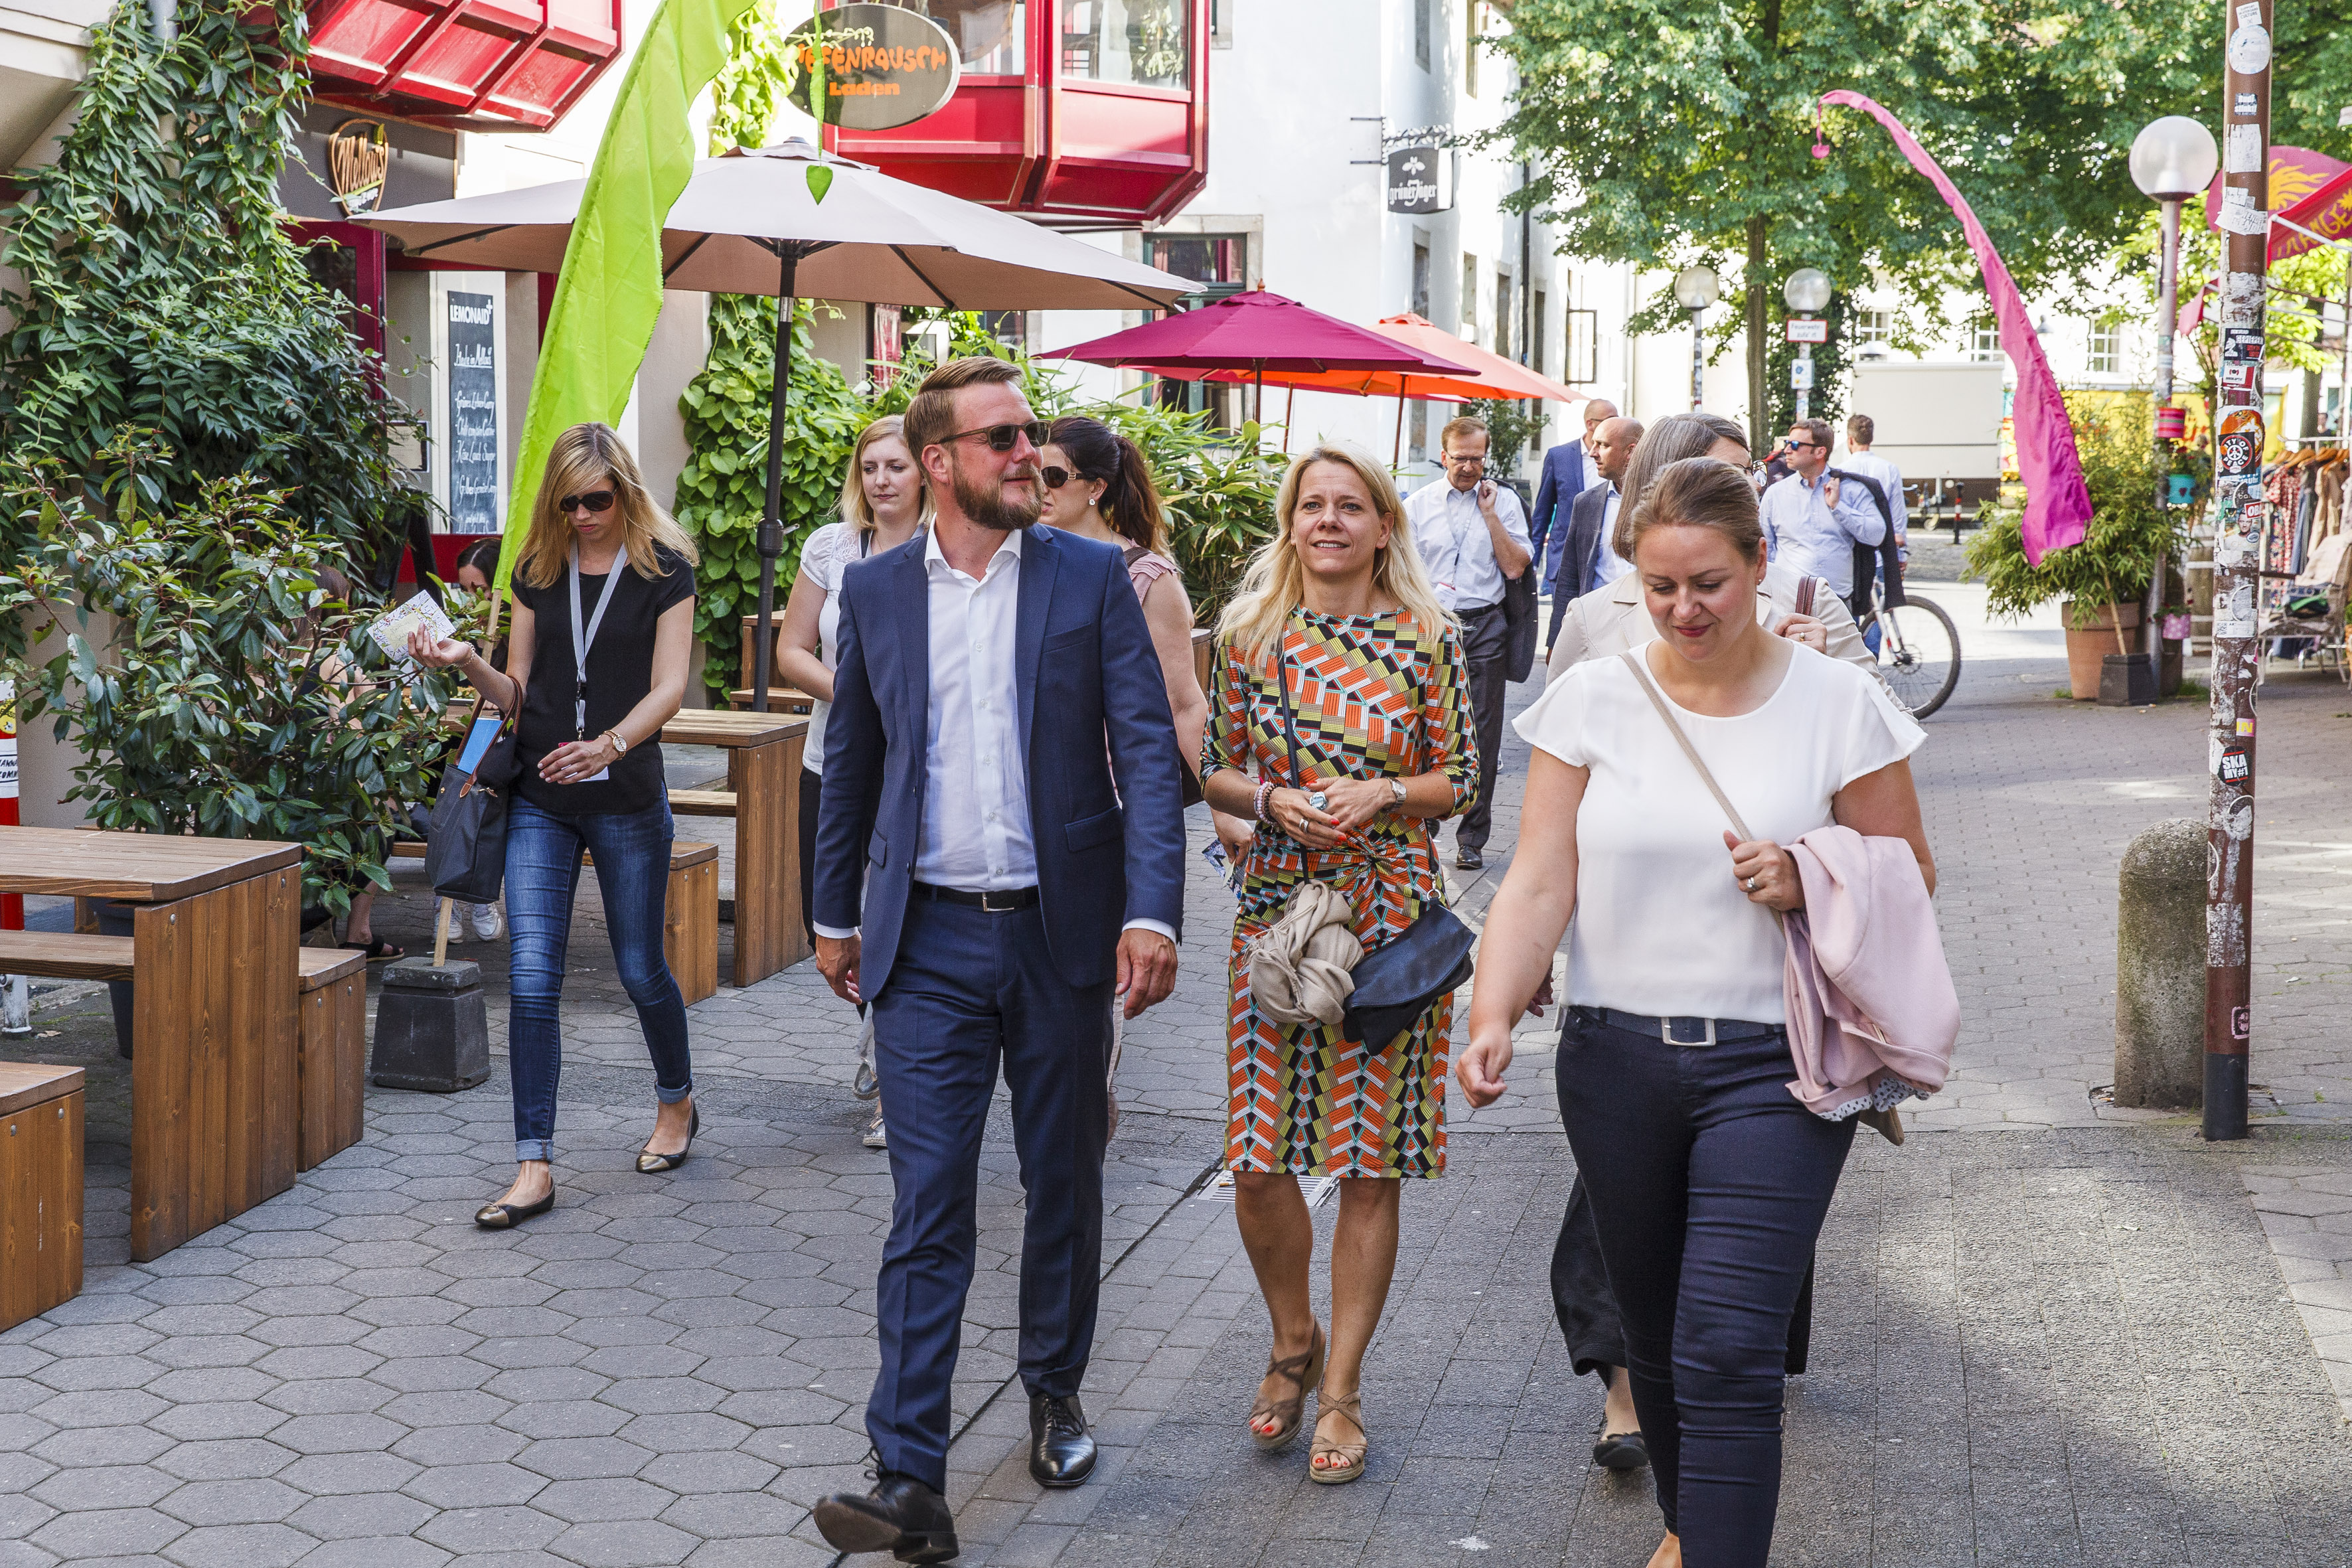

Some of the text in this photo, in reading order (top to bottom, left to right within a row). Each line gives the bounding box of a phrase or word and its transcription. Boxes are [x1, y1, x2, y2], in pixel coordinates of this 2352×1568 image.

[798, 43, 947, 74] IEFENRAUSCH
[829, 82, 900, 96] Laden
[2224, 438, 2249, 451] ITY OF
[2223, 455, 2249, 466] PEACE
[2222, 753, 2248, 770] SKA
